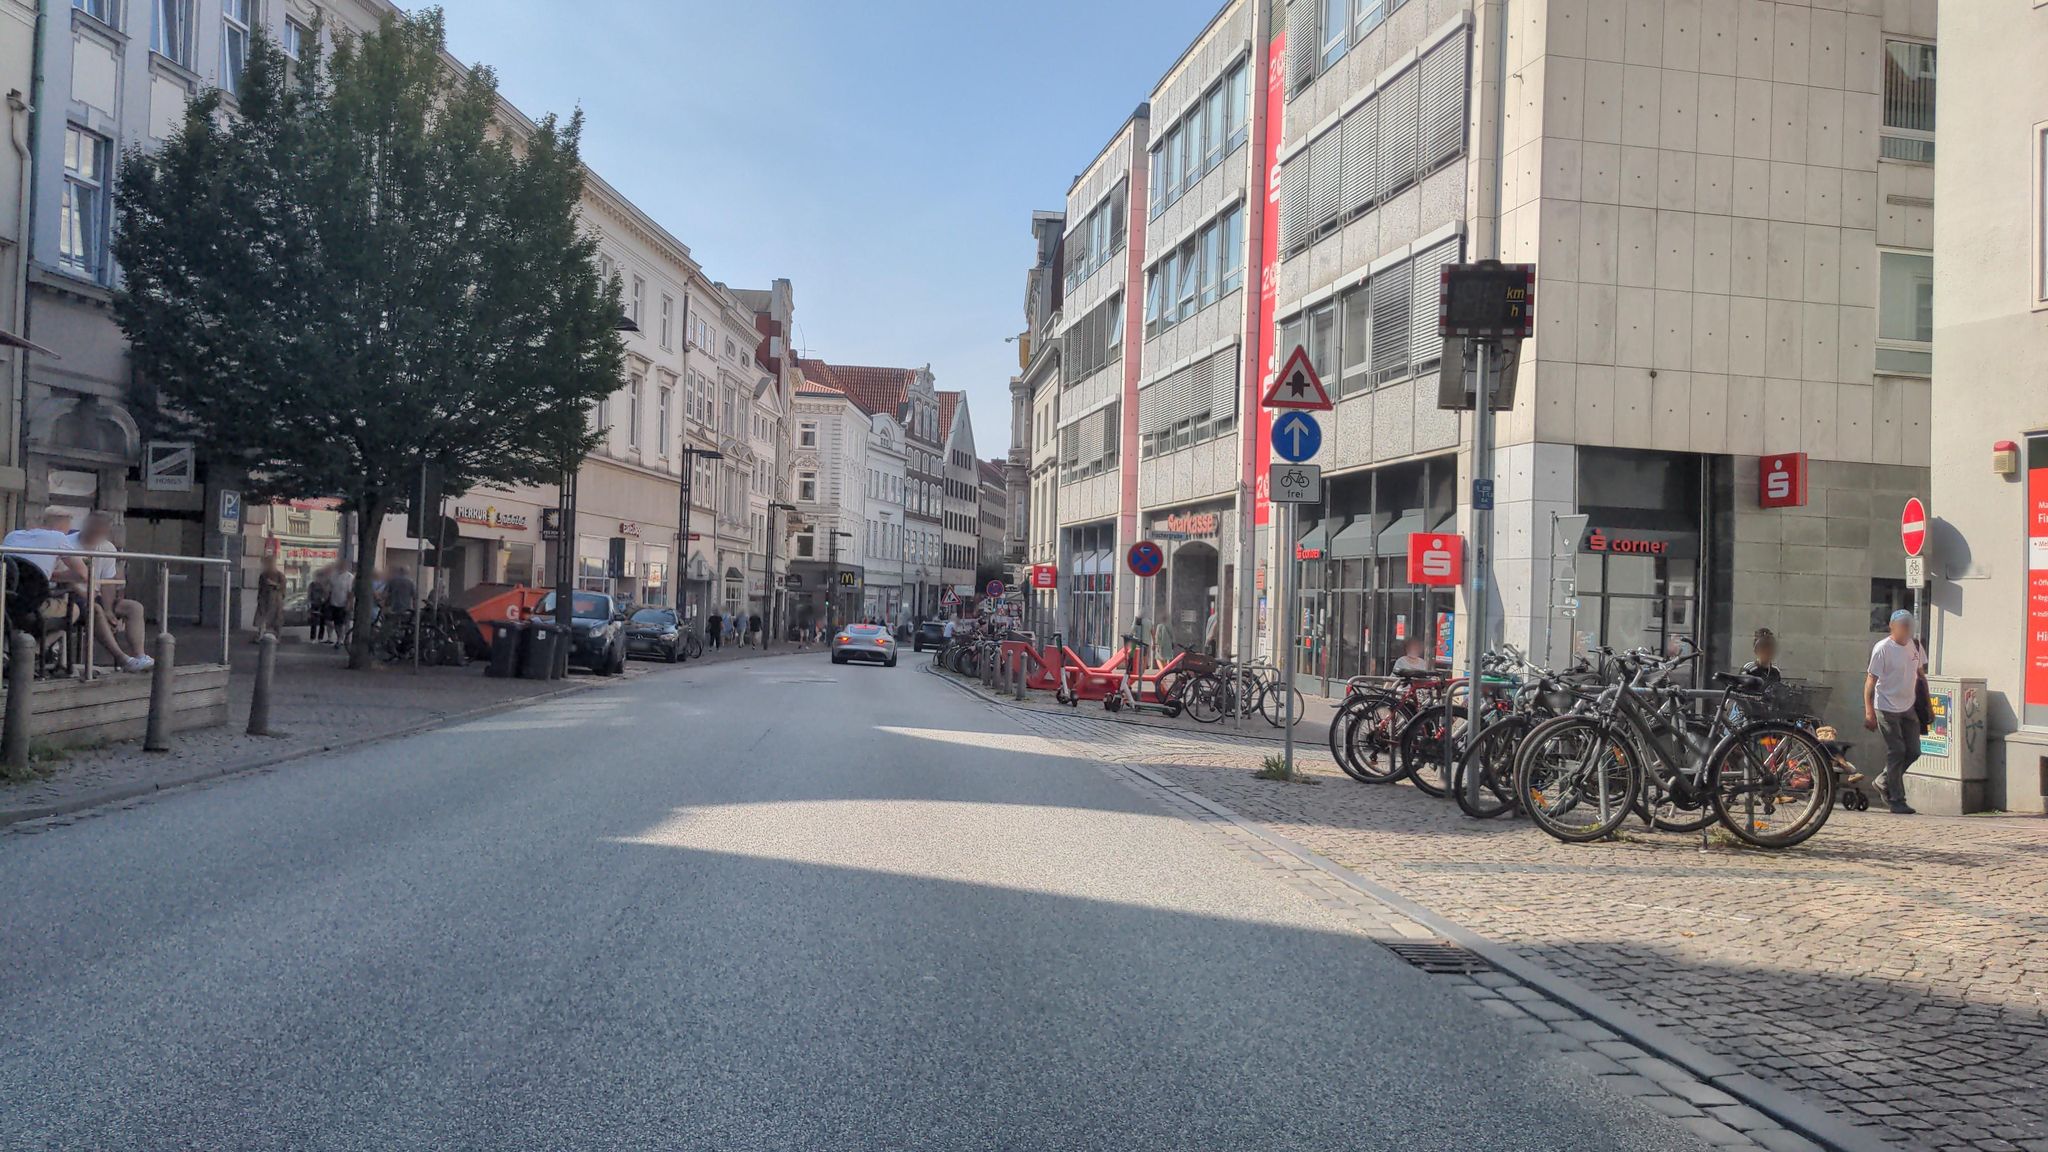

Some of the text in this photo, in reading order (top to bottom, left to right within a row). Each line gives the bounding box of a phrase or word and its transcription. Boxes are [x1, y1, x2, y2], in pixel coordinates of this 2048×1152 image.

[1506, 286, 1525, 300] km
[1510, 304, 1519, 318] h
[1287, 489, 1304, 499] frei
[458, 506, 488, 521] MERKUR
[1167, 511, 1214, 534] Sparkasse
[1612, 538, 1668, 553] corner
